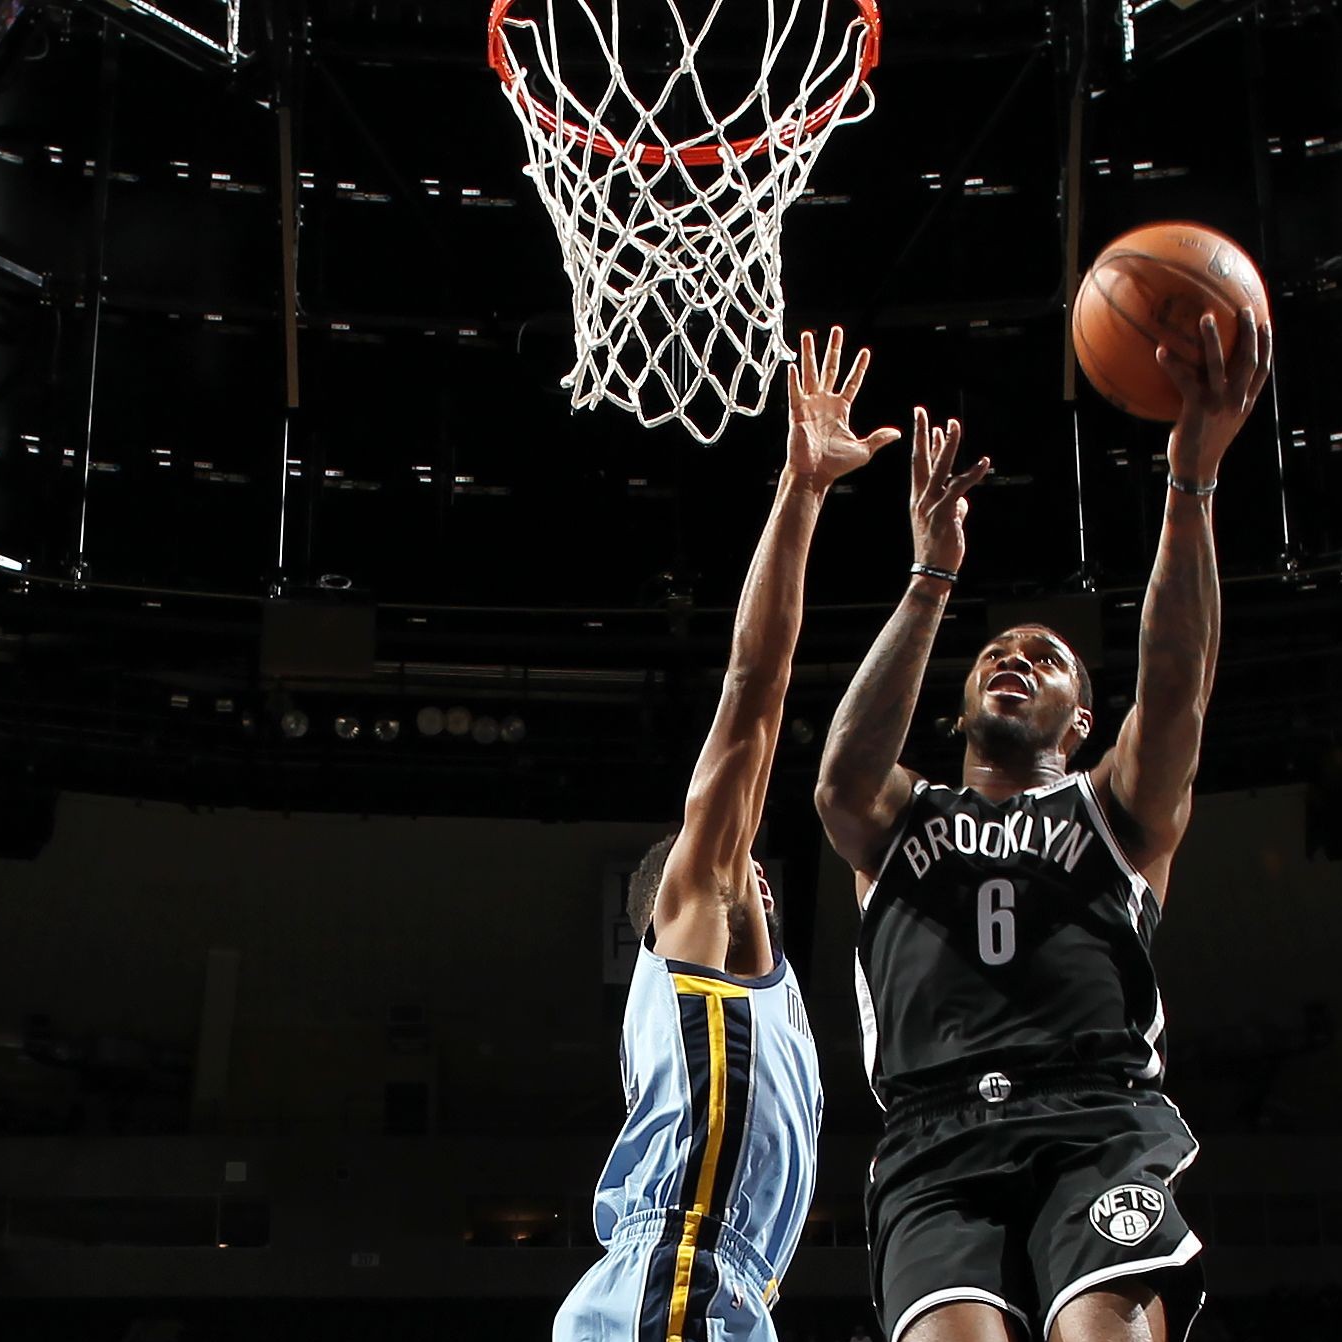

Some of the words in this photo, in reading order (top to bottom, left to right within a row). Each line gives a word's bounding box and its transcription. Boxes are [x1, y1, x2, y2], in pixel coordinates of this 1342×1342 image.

[902, 810, 1094, 881] BROOKLYN
[977, 877, 1017, 967] 6
[1093, 1186, 1163, 1220] NETS
[1123, 1214, 1137, 1236] B
